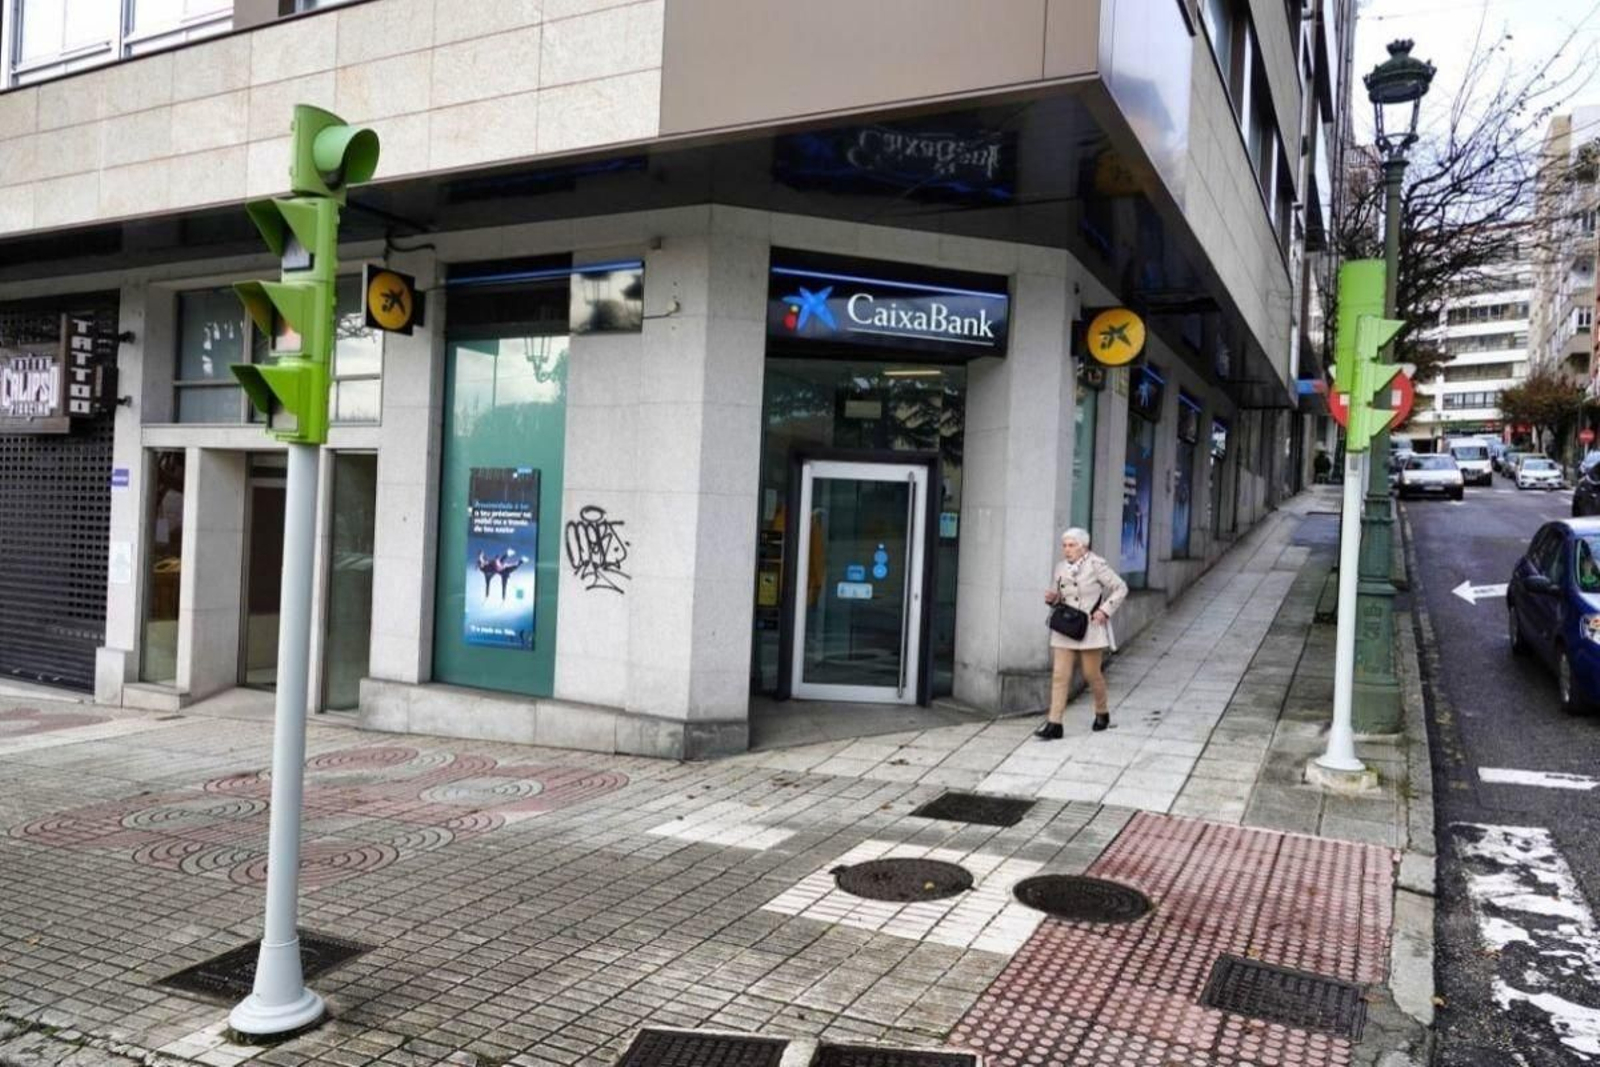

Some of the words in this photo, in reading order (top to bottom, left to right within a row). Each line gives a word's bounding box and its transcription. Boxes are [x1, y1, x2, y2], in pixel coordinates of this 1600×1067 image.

[847, 293, 994, 338] CaixaBank
[1, 366, 58, 408] CALIPSO
[69, 319, 93, 414] TATTOO
